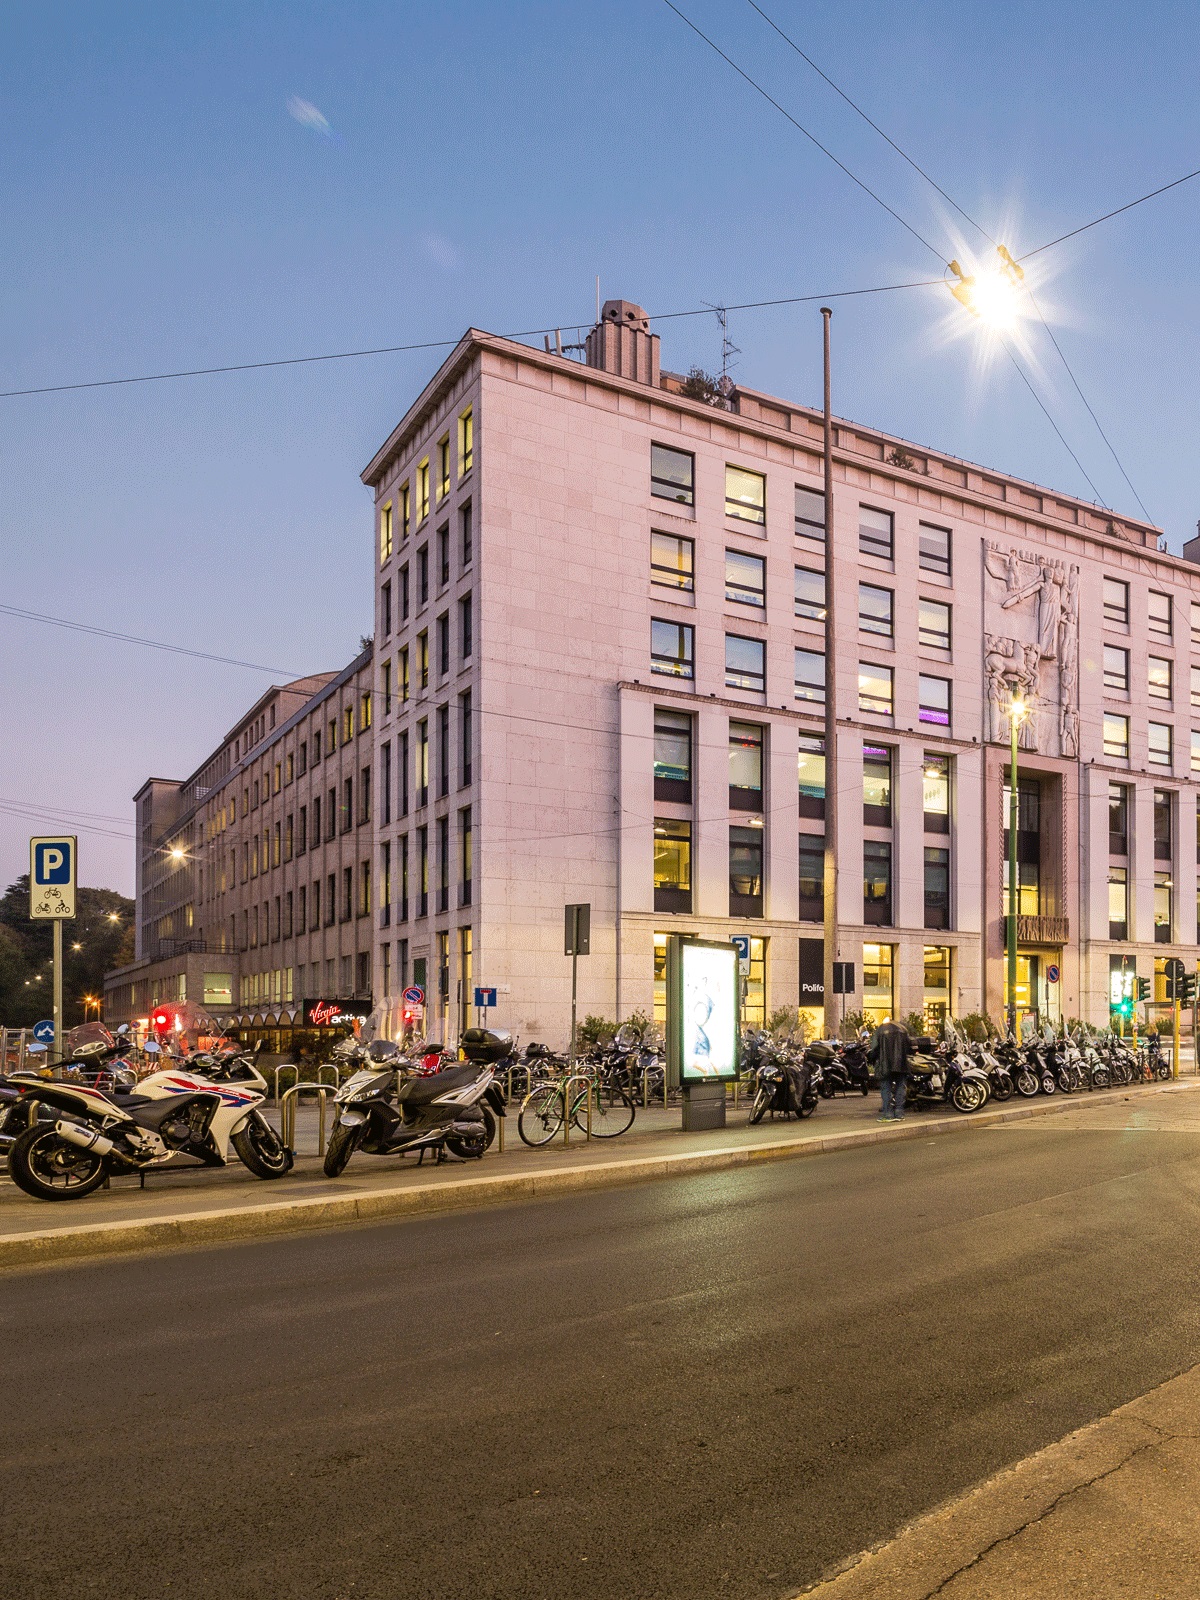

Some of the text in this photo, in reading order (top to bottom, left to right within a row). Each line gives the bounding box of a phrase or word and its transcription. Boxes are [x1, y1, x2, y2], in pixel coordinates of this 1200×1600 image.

[43, 848, 63, 880] P
[802, 983, 825, 993] Polifo
[309, 1001, 342, 1025] Virgin
